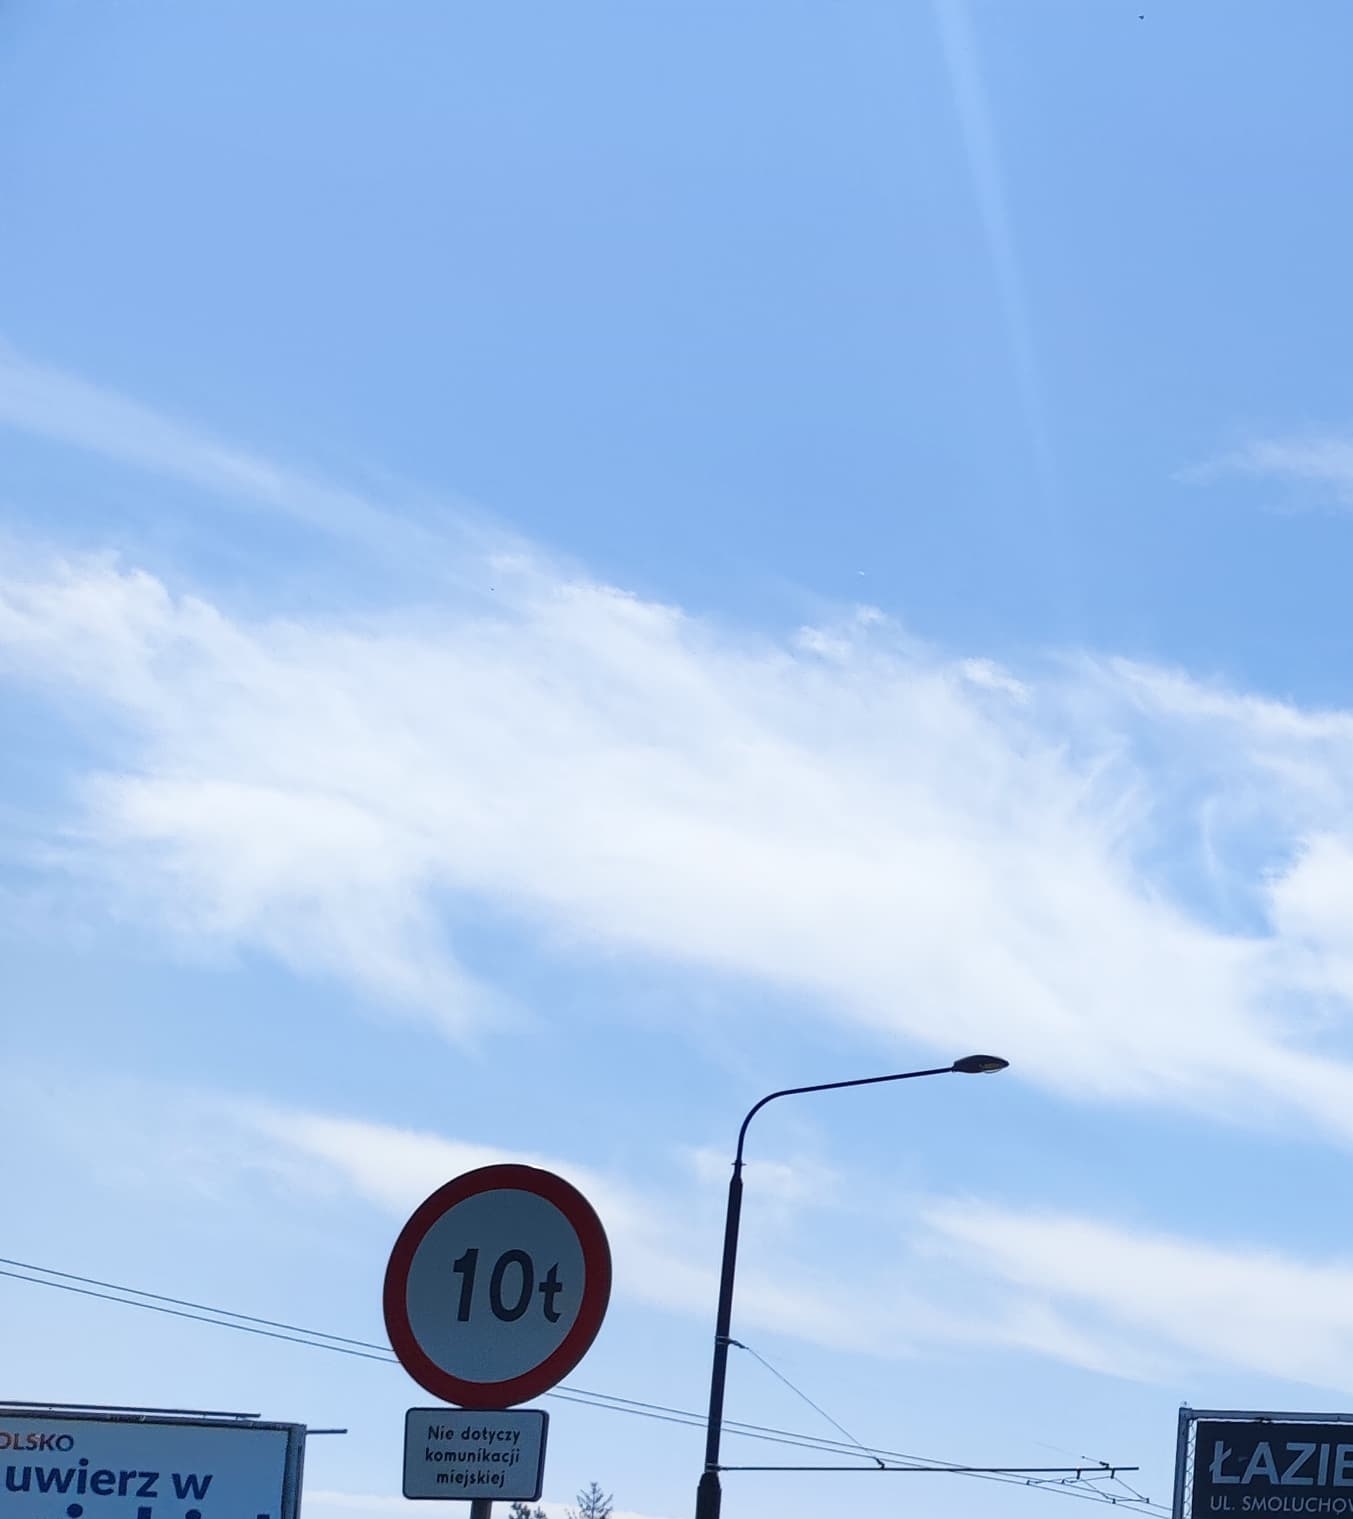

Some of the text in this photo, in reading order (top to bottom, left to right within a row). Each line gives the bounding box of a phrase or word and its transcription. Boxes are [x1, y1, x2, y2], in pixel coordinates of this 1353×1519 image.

[453, 1248, 563, 1324] 10t
[427, 1425, 520, 1445] Nie dotyczy
[425, 1448, 520, 1466] komunikacji
[5, 1457, 213, 1500] uwierz w
[436, 1469, 505, 1488] miejskiej
[1210, 1496, 1236, 1511] UL.
